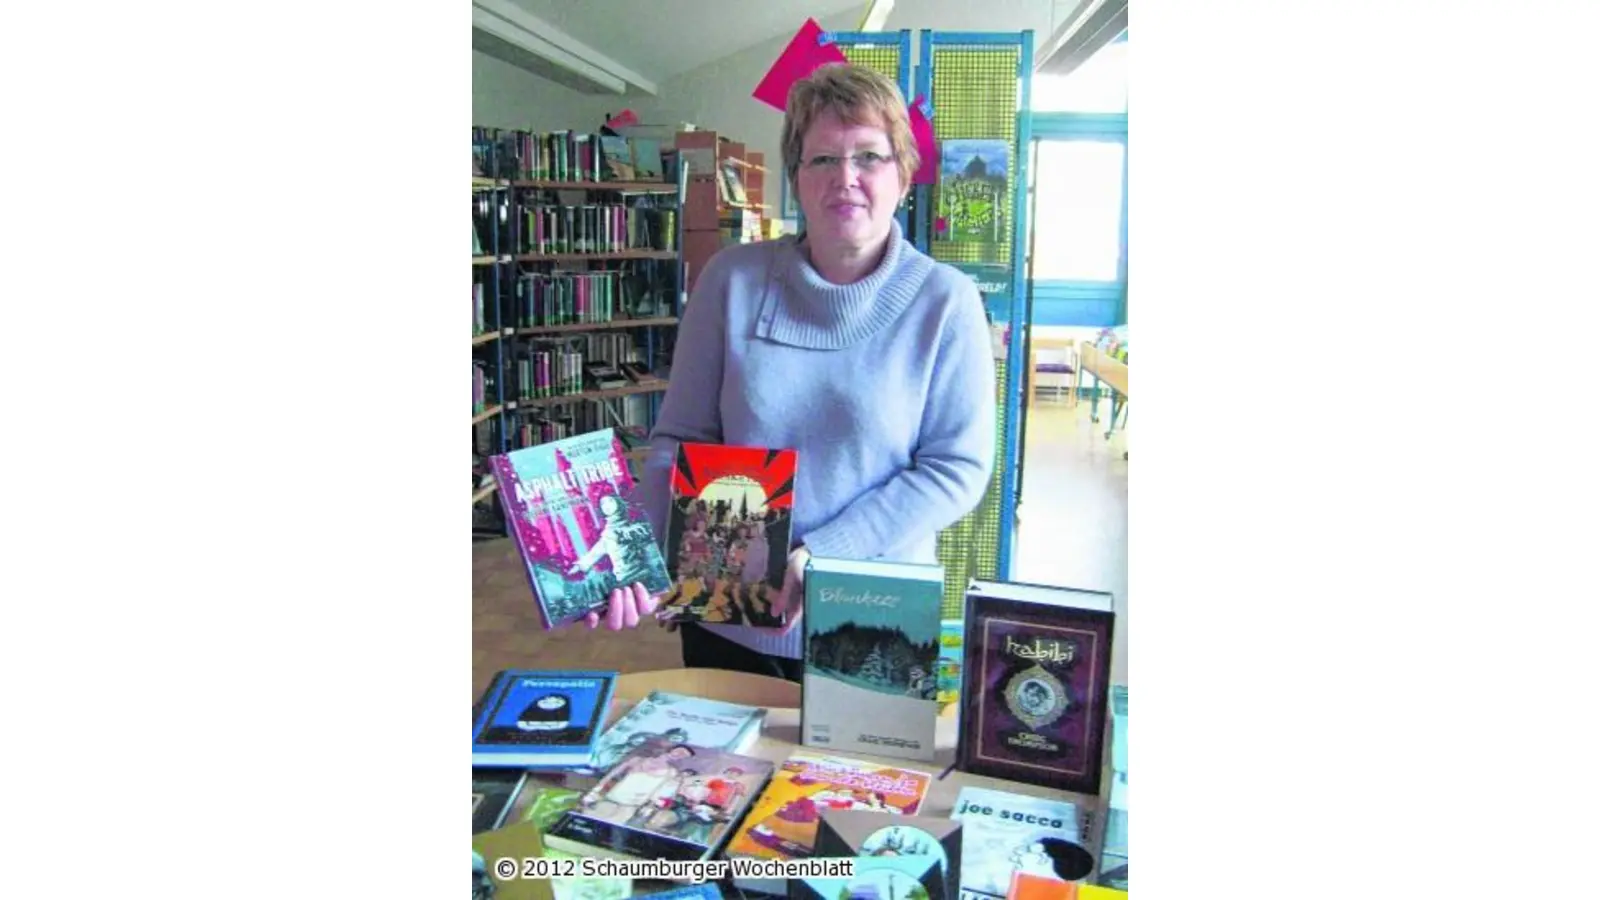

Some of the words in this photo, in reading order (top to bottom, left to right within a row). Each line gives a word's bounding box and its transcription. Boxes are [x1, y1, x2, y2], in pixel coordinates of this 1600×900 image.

[578, 457, 624, 484] TRIBE
[959, 800, 993, 816] joe
[999, 808, 1064, 829] sacco
